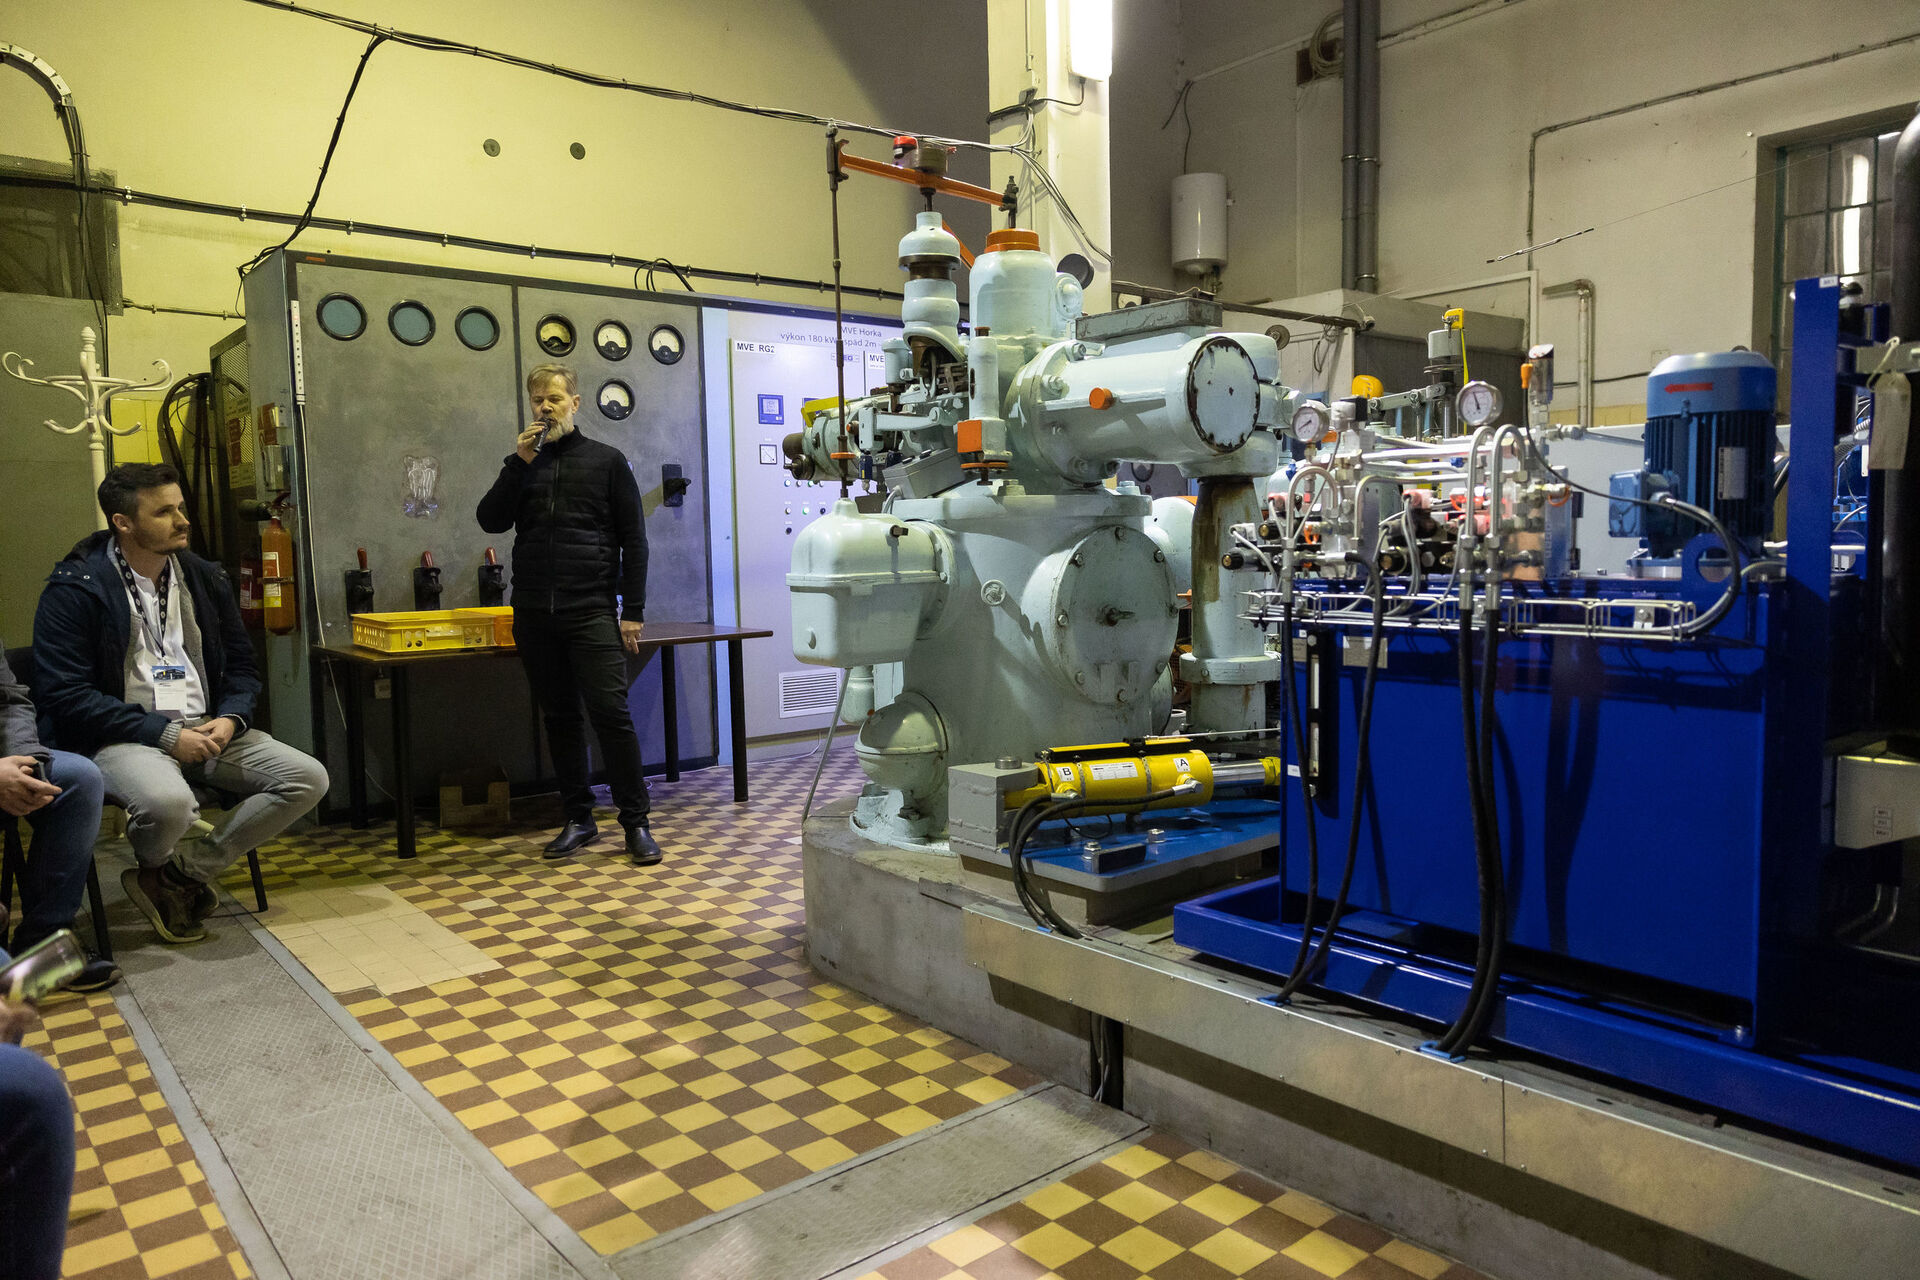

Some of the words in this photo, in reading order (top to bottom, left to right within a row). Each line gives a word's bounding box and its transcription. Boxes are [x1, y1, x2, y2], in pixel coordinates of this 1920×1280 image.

[841, 326, 858, 335] MVE
[859, 328, 882, 338] Horka
[780, 332, 805, 342] výkon
[808, 334, 823, 343] 180
[864, 340, 877, 348] 2m
[737, 342, 754, 352] MVE
[869, 354, 884, 363] MVE
[1179, 758, 1189, 767] A
[1062, 767, 1072, 776] B
